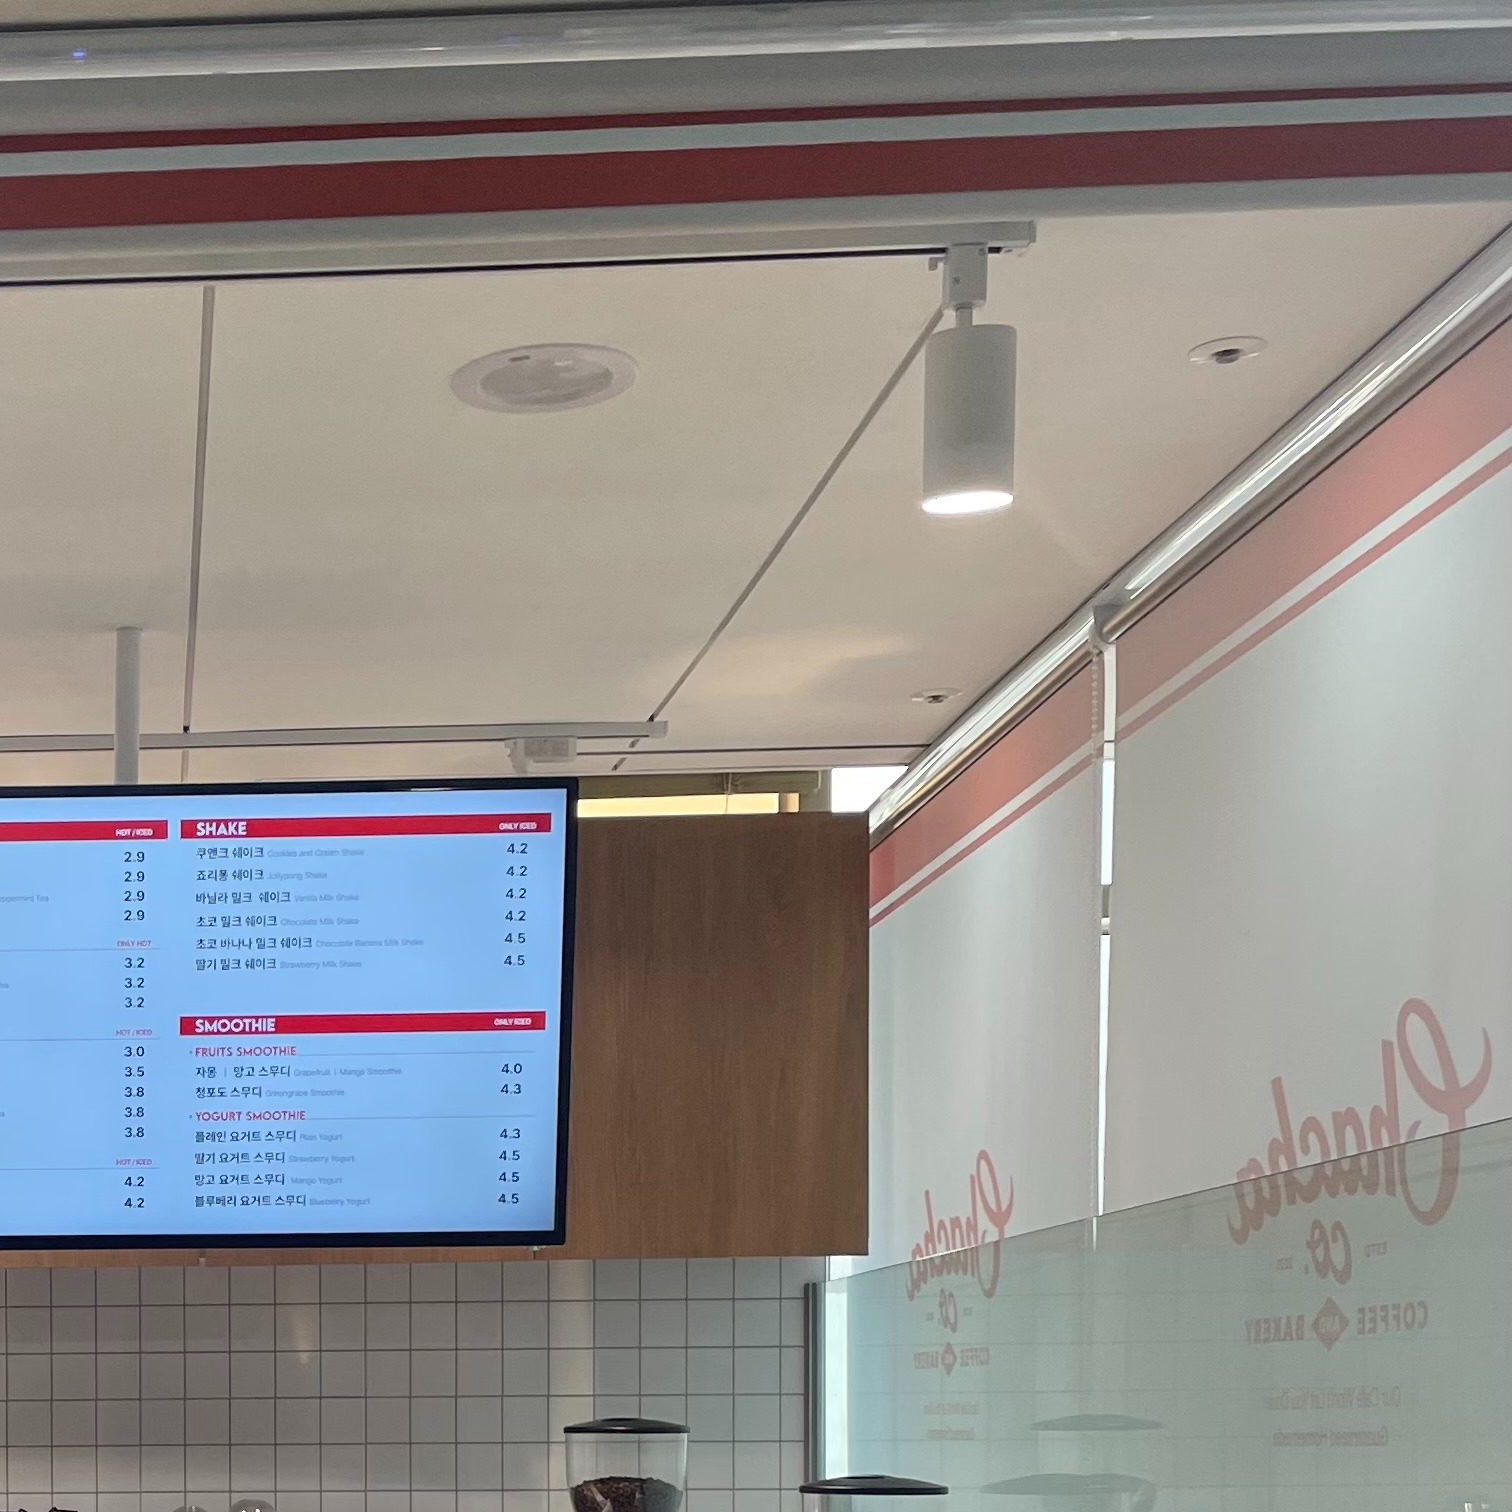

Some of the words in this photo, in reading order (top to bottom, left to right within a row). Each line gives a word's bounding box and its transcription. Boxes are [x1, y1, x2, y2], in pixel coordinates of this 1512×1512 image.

[197, 822, 247, 836] SHAKE
[507, 843, 527, 854] 4.2
[125, 852, 144, 862] 2.9
[507, 866, 527, 876] 4.2
[125, 871, 144, 882] 2.9
[125, 891, 144, 901] 2.9
[125, 958, 144, 968] 3.2
[195, 1018, 276, 1032] SMOOTHIE
[124, 1046, 144, 1057] 3.0
[196, 1047, 232, 1057] FRUITS
[237, 1046, 296, 1056] SMOOTHIE
[502, 1063, 522, 1074] 4.0
[501, 1084, 521, 1094] 4.3
[125, 1107, 144, 1117] 3.8
[196, 1112, 242, 1121] YOGURT
[246, 1111, 305, 1120] SMOOTHIE
[500, 1129, 520, 1138] 4.3
